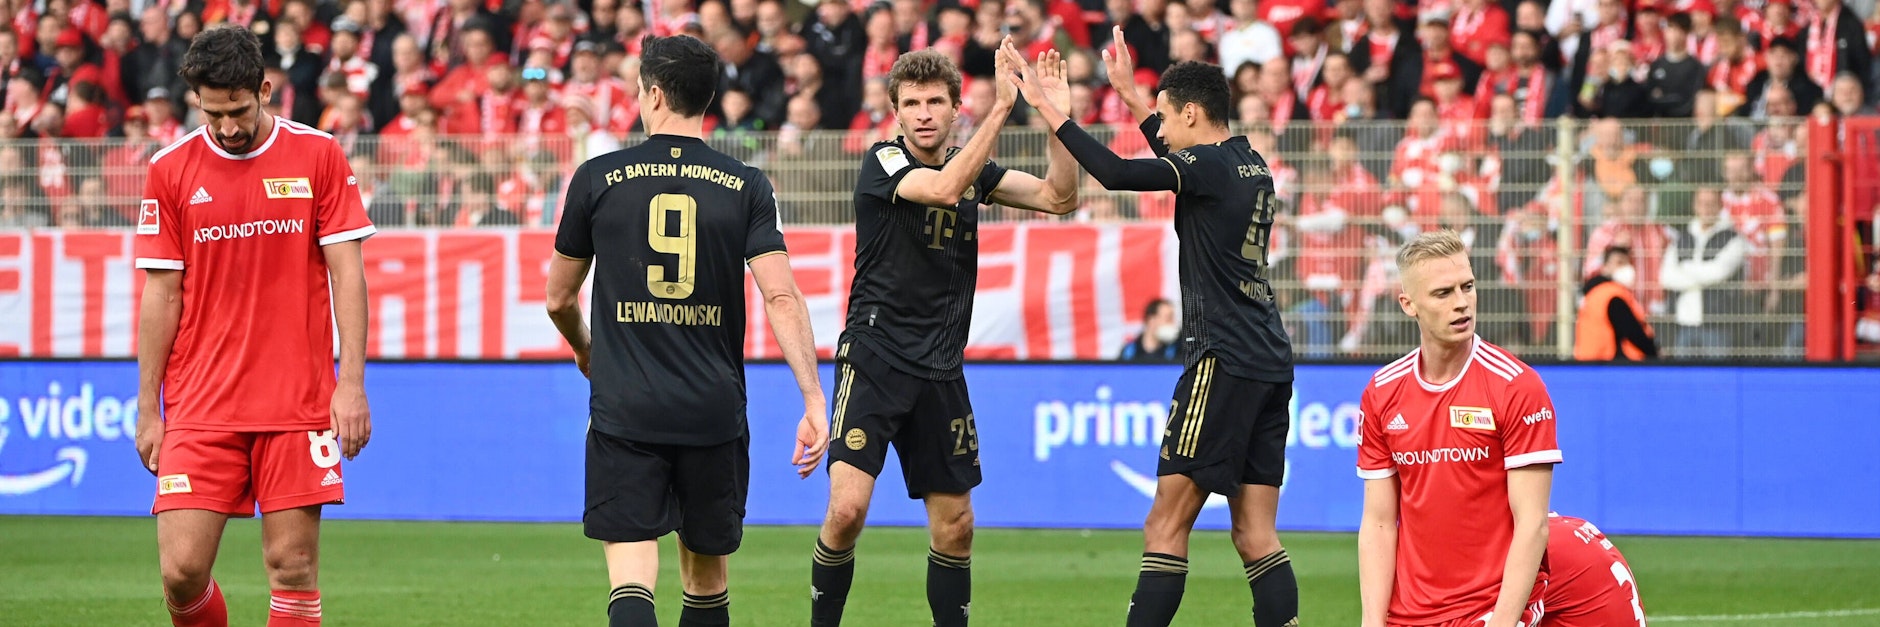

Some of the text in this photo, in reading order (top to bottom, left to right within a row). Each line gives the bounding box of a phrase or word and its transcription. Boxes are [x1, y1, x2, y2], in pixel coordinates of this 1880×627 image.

[605, 163, 745, 192] FC BAYERN MÜNCHEN
[190, 195, 213, 205] adidas
[193, 218, 304, 244] AROUNDTOWN
[647, 193, 697, 300] 9
[616, 302, 722, 327] LEWANDOWSKI
[1034, 385, 1166, 461] prim
[1392, 447, 1490, 465] AROUNDTOWN
